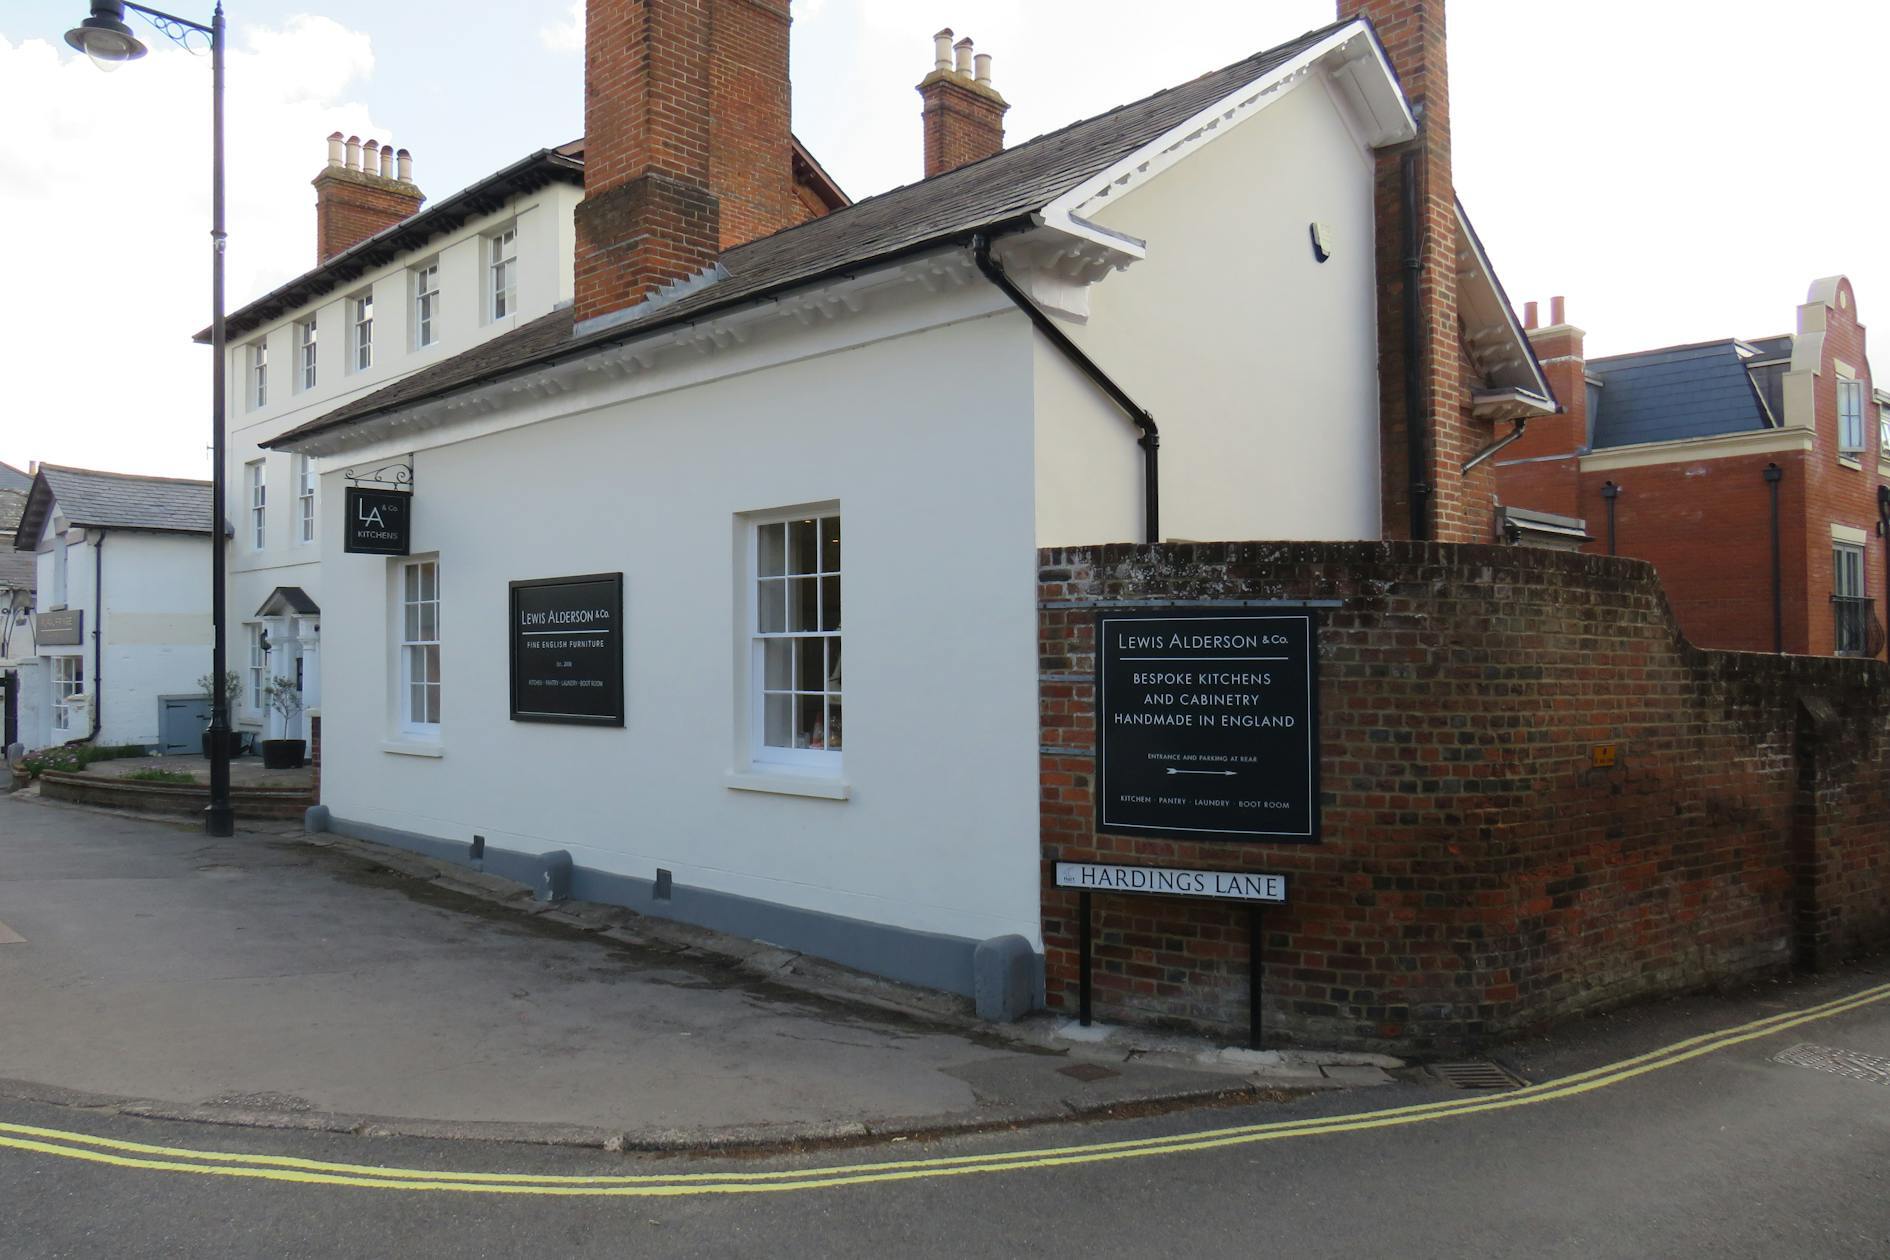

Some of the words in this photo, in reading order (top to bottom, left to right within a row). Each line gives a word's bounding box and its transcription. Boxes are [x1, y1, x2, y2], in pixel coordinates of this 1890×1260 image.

[359, 498, 385, 528] LA
[358, 531, 399, 540] KITCHENS
[522, 610, 546, 625] LEWIS
[548, 610, 594, 624] ALDERSON
[542, 641, 568, 649] ENGLISH
[570, 640, 605, 648] FURNITURE
[1119, 633, 1164, 650] LEWIS
[1169, 633, 1257, 649] ALDERSON
[1134, 674, 1192, 685] BESPOKE
[1199, 674, 1271, 685] KITCHENS
[1144, 694, 1174, 705] AND
[1180, 694, 1260, 706] CABINETRY
[1114, 713, 1193, 726] HANDMADE
[1199, 715, 1215, 726] IN
[1222, 715, 1296, 728] ENGLAND
[1148, 753, 1181, 761] ENTRANCE
[1199, 754, 1228, 763] PARKING
[1121, 795, 1152, 803] KITCHEN
[1159, 797, 1186, 806] PANTRY
[1194, 799, 1230, 807] LAUNDRY
[1239, 800, 1261, 808] BOOT
[1264, 801, 1290, 809] ROOM
[1081, 867, 1205, 892] HARDINGS
[1216, 875, 1278, 897] LANE
